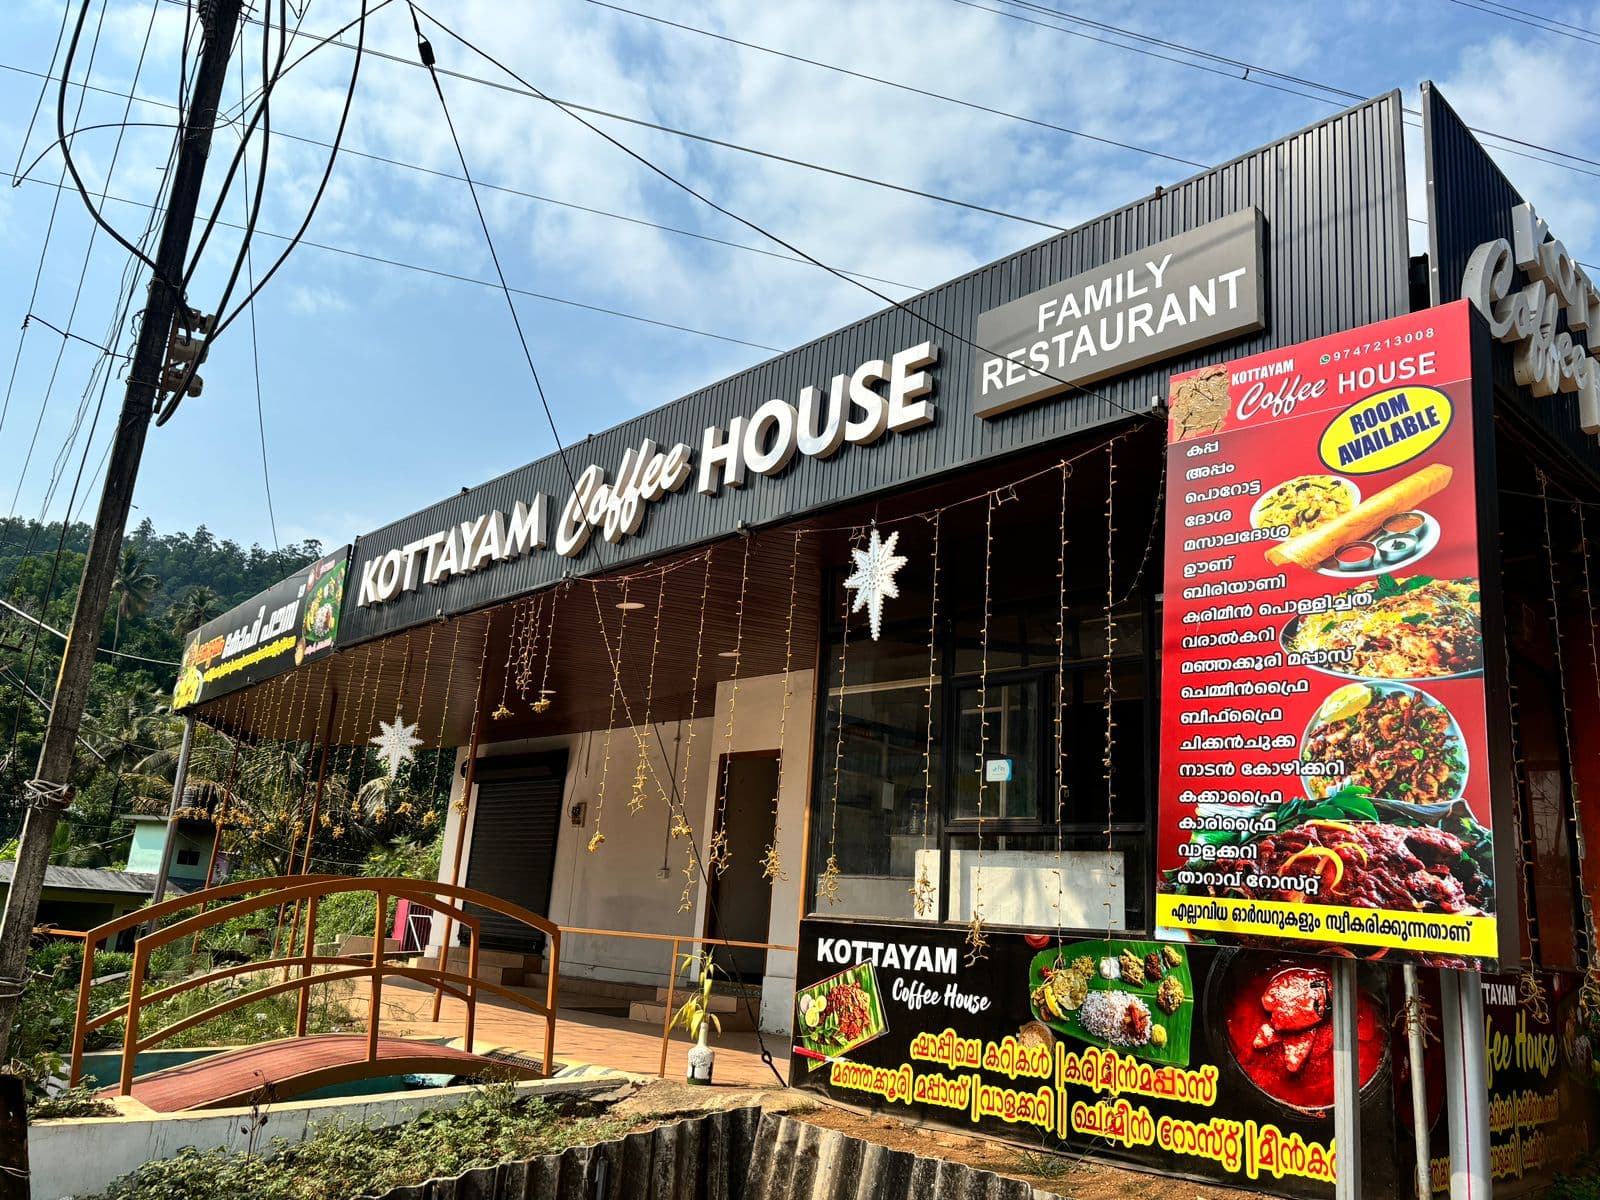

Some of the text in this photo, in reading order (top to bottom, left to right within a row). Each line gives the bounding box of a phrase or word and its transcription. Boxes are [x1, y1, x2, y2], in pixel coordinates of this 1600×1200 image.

[1038, 253, 1173, 333] FAMILY
[982, 267, 1246, 395] RESTAURANT
[1333, 328, 1434, 361] 9747213008
[1231, 359, 1294, 386] KOTTAYAM
[1236, 351, 1436, 421] Coffee HOUSE
[1350, 393, 1410, 435] ROOM
[1187, 441, 1219, 457] കപ്പ
[1338, 405, 1440, 466] AVAILABLE
[357, 340, 937, 607] KOTTAYAM Coffee HOUSE
[1186, 463, 1235, 480] അപ്പം
[1185, 480, 1260, 503] പൊറോട്ട
[1184, 510, 1232, 527] ദോശ
[1184, 525, 1290, 551] മസാലദോശ
[1183, 554, 1234, 577] ഊണ്
[1183, 574, 1286, 600] ബിരിയാണി
[1182, 590, 1375, 624] കരിമീൻ പൊള്ളിച്ചത്
[1182, 627, 1275, 648] വരാൽകറി
[1287, 645, 1355, 666] മപ്പാസ്
[1179, 734, 1296, 751] ചിക്കൻചുക്ക
[1179, 759, 1345, 776] നാടൻ കോഴിക്കറി
[1178, 843, 1257, 860] വാളക്കറി
[1177, 870, 1243, 887] താറാവ്
[1171, 901, 1473, 942] എല്ലാവിധ ഓർഡറുകളും സ്വീകരിക്കുന്നതാണ്
[817, 937, 958, 974] KOTTAYAM
[892, 977, 992, 1014] Coffee House
[912, 1029, 981, 1069] ഷാപ്പിലെ
[984, 1036, 1052, 1079] കറികൾ
[1515, 1009, 1557, 1079] House
[1258, 1124, 1336, 1184] മീൻക
